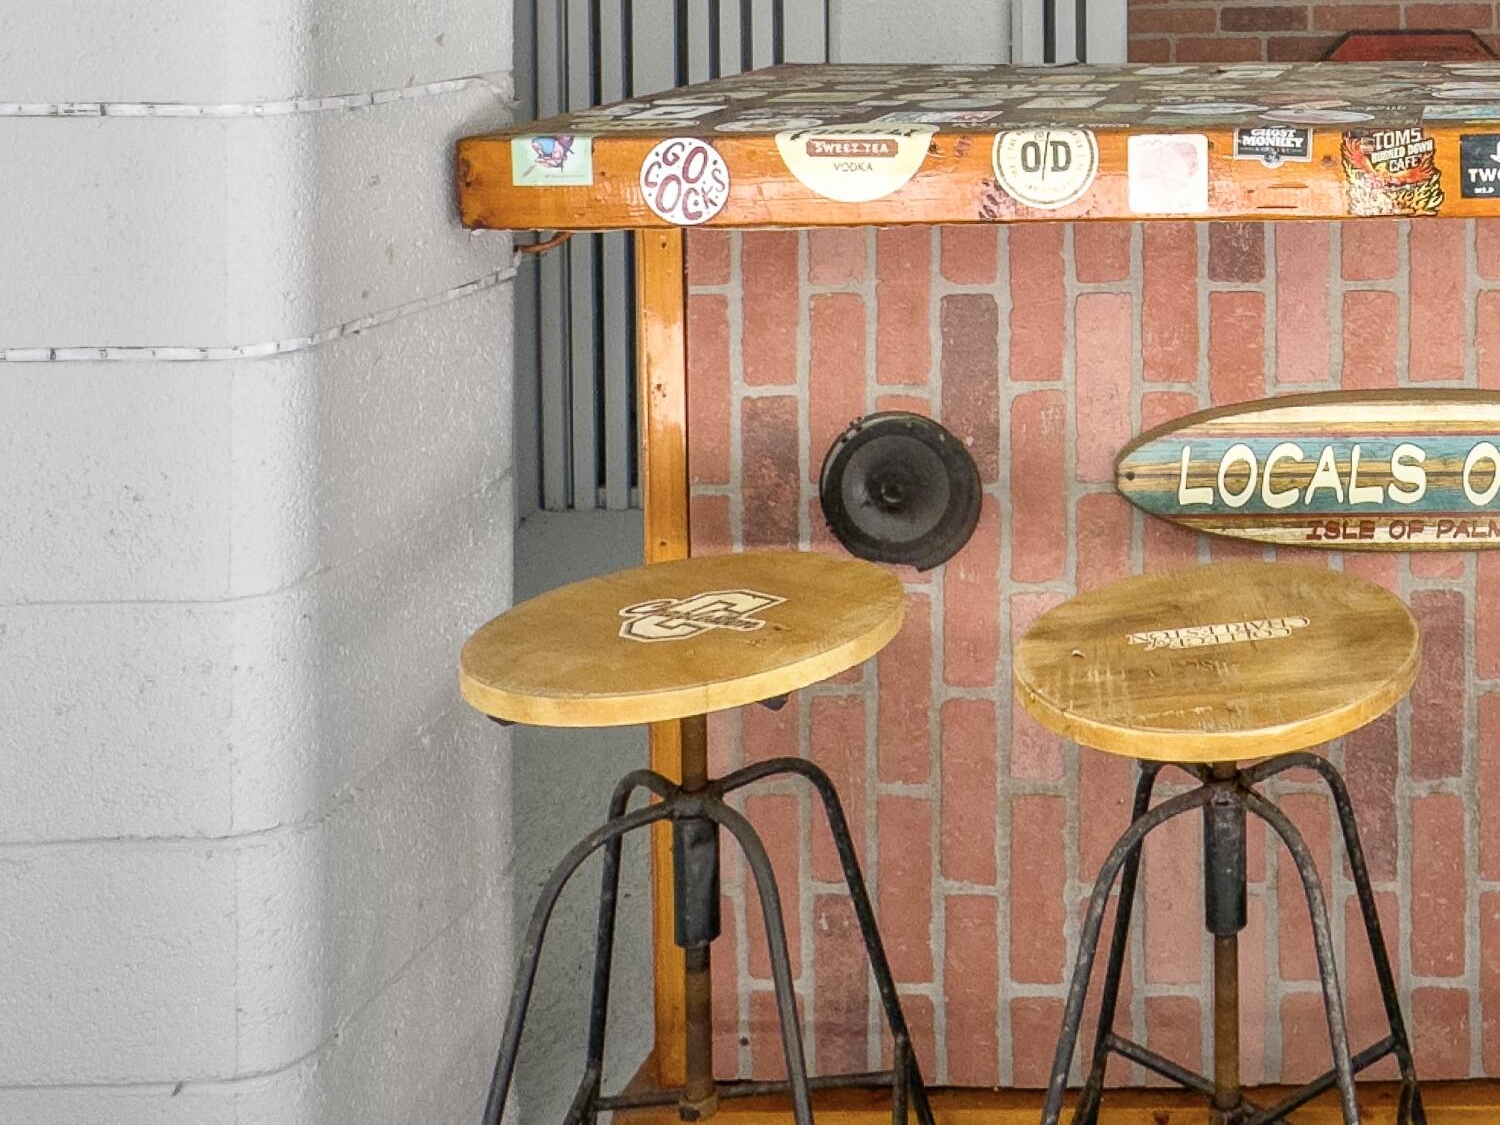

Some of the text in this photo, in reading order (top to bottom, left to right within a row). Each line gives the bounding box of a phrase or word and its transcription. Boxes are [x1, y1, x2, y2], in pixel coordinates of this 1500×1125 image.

[815, 141, 890, 155] SWEET TEA
[1241, 136, 1304, 148] MONKEY
[1372, 127, 1422, 150] TOMS
[662, 141, 708, 184] GO
[833, 162, 873, 173] VODKA
[1389, 155, 1419, 173] CAFE
[644, 160, 726, 220] COCKS
[1177, 442, 1427, 509] LOCALS
[1305, 519, 1377, 541] ISLE
[1388, 519, 1424, 541] OF
